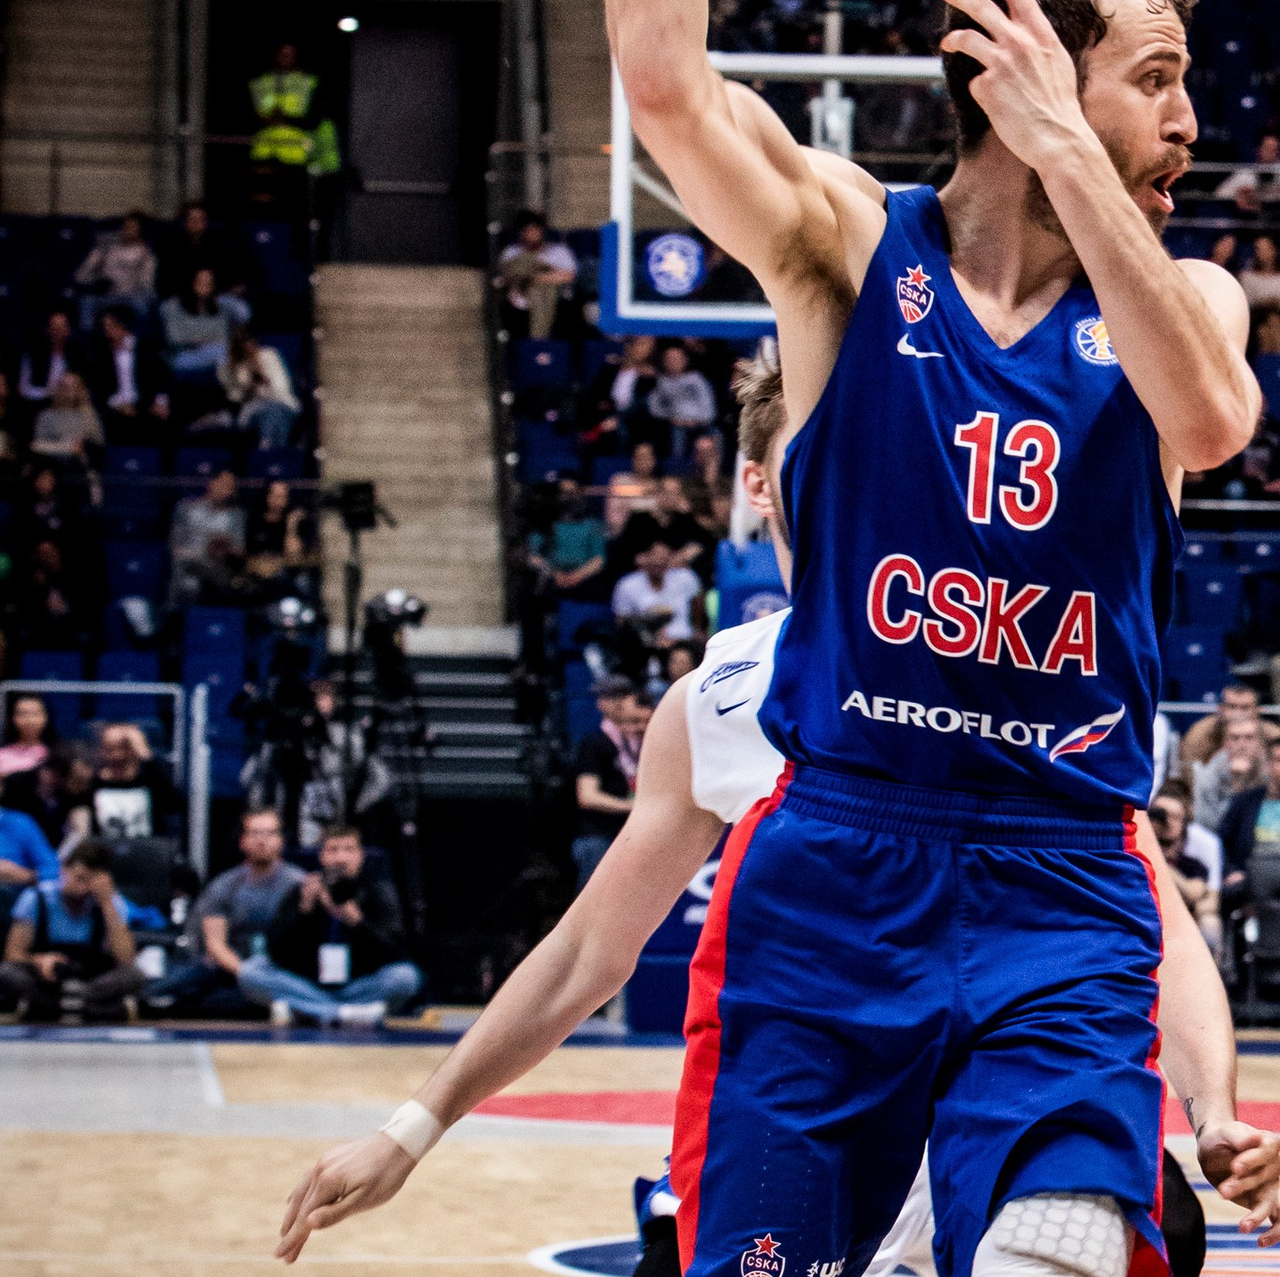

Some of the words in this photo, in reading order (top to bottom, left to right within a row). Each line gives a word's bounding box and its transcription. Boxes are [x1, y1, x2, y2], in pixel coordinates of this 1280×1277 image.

[900, 283, 927, 305] CSKA
[954, 410, 1061, 531] 13
[866, 553, 1098, 677] CSKA
[841, 690, 1056, 749] AEROFLOT
[746, 1255, 779, 1272] CSKA
